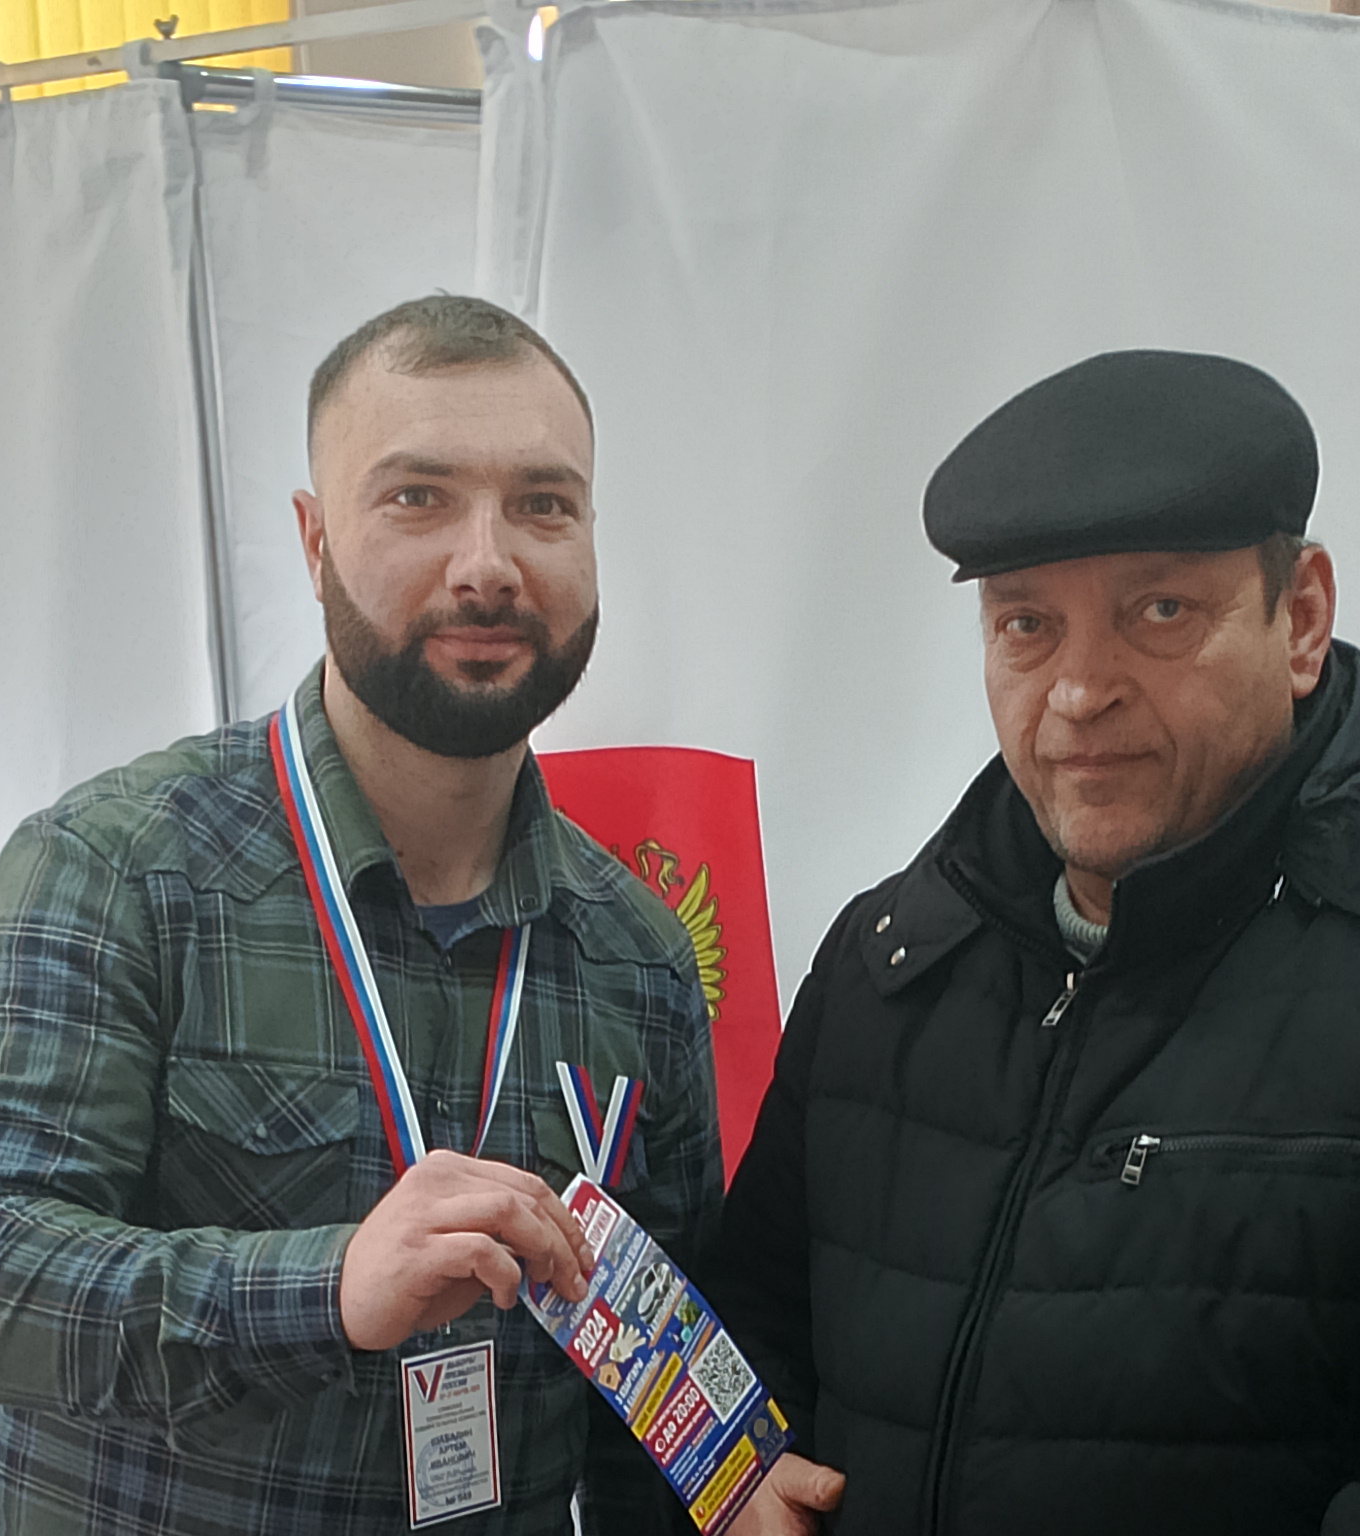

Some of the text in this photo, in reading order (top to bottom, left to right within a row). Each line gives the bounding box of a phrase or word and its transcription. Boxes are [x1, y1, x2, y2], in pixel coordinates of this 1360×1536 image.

[571, 1307, 609, 1360] 2024
[661, 1384, 700, 1444] ДО 20:00
